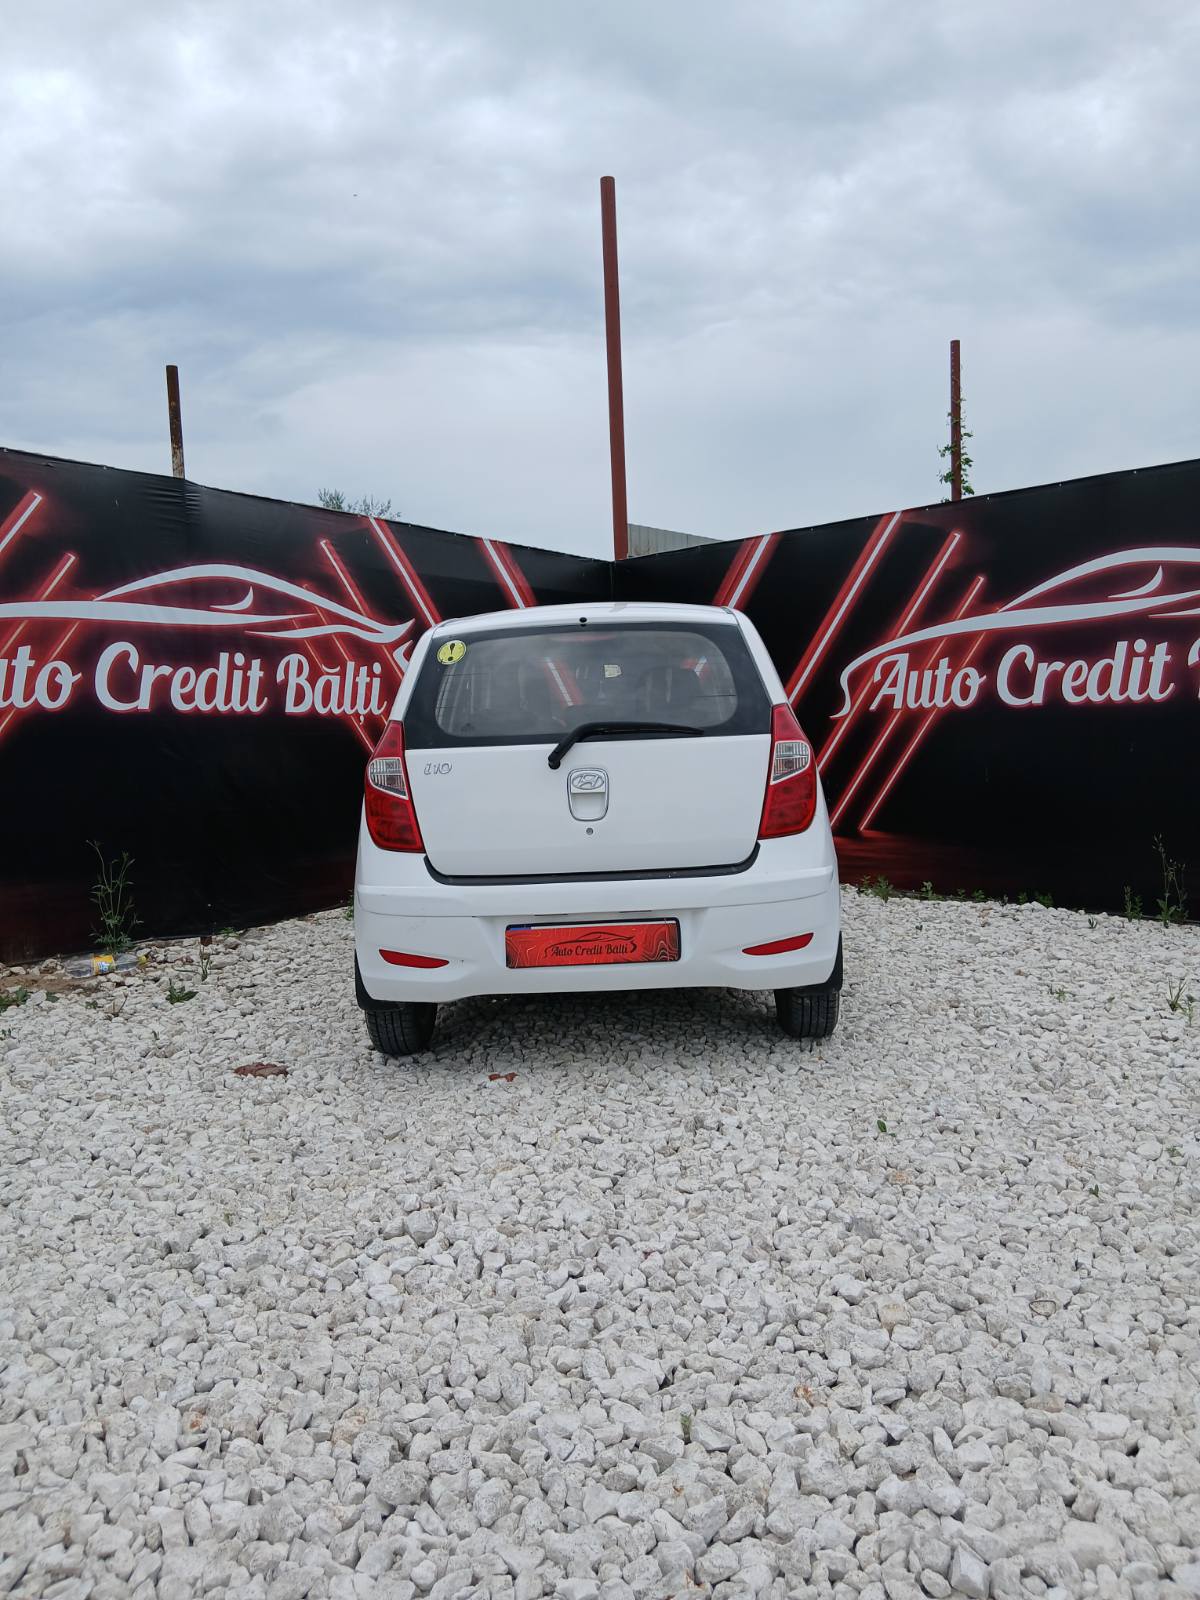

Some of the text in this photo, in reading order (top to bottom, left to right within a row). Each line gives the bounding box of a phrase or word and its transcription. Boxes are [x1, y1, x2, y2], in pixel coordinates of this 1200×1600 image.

[94, 641, 268, 711] Credit
[276, 653, 388, 725] Bălți
[869, 653, 987, 712] Auto
[996, 638, 1175, 706] Credit
[552, 945, 573, 957] Auto
